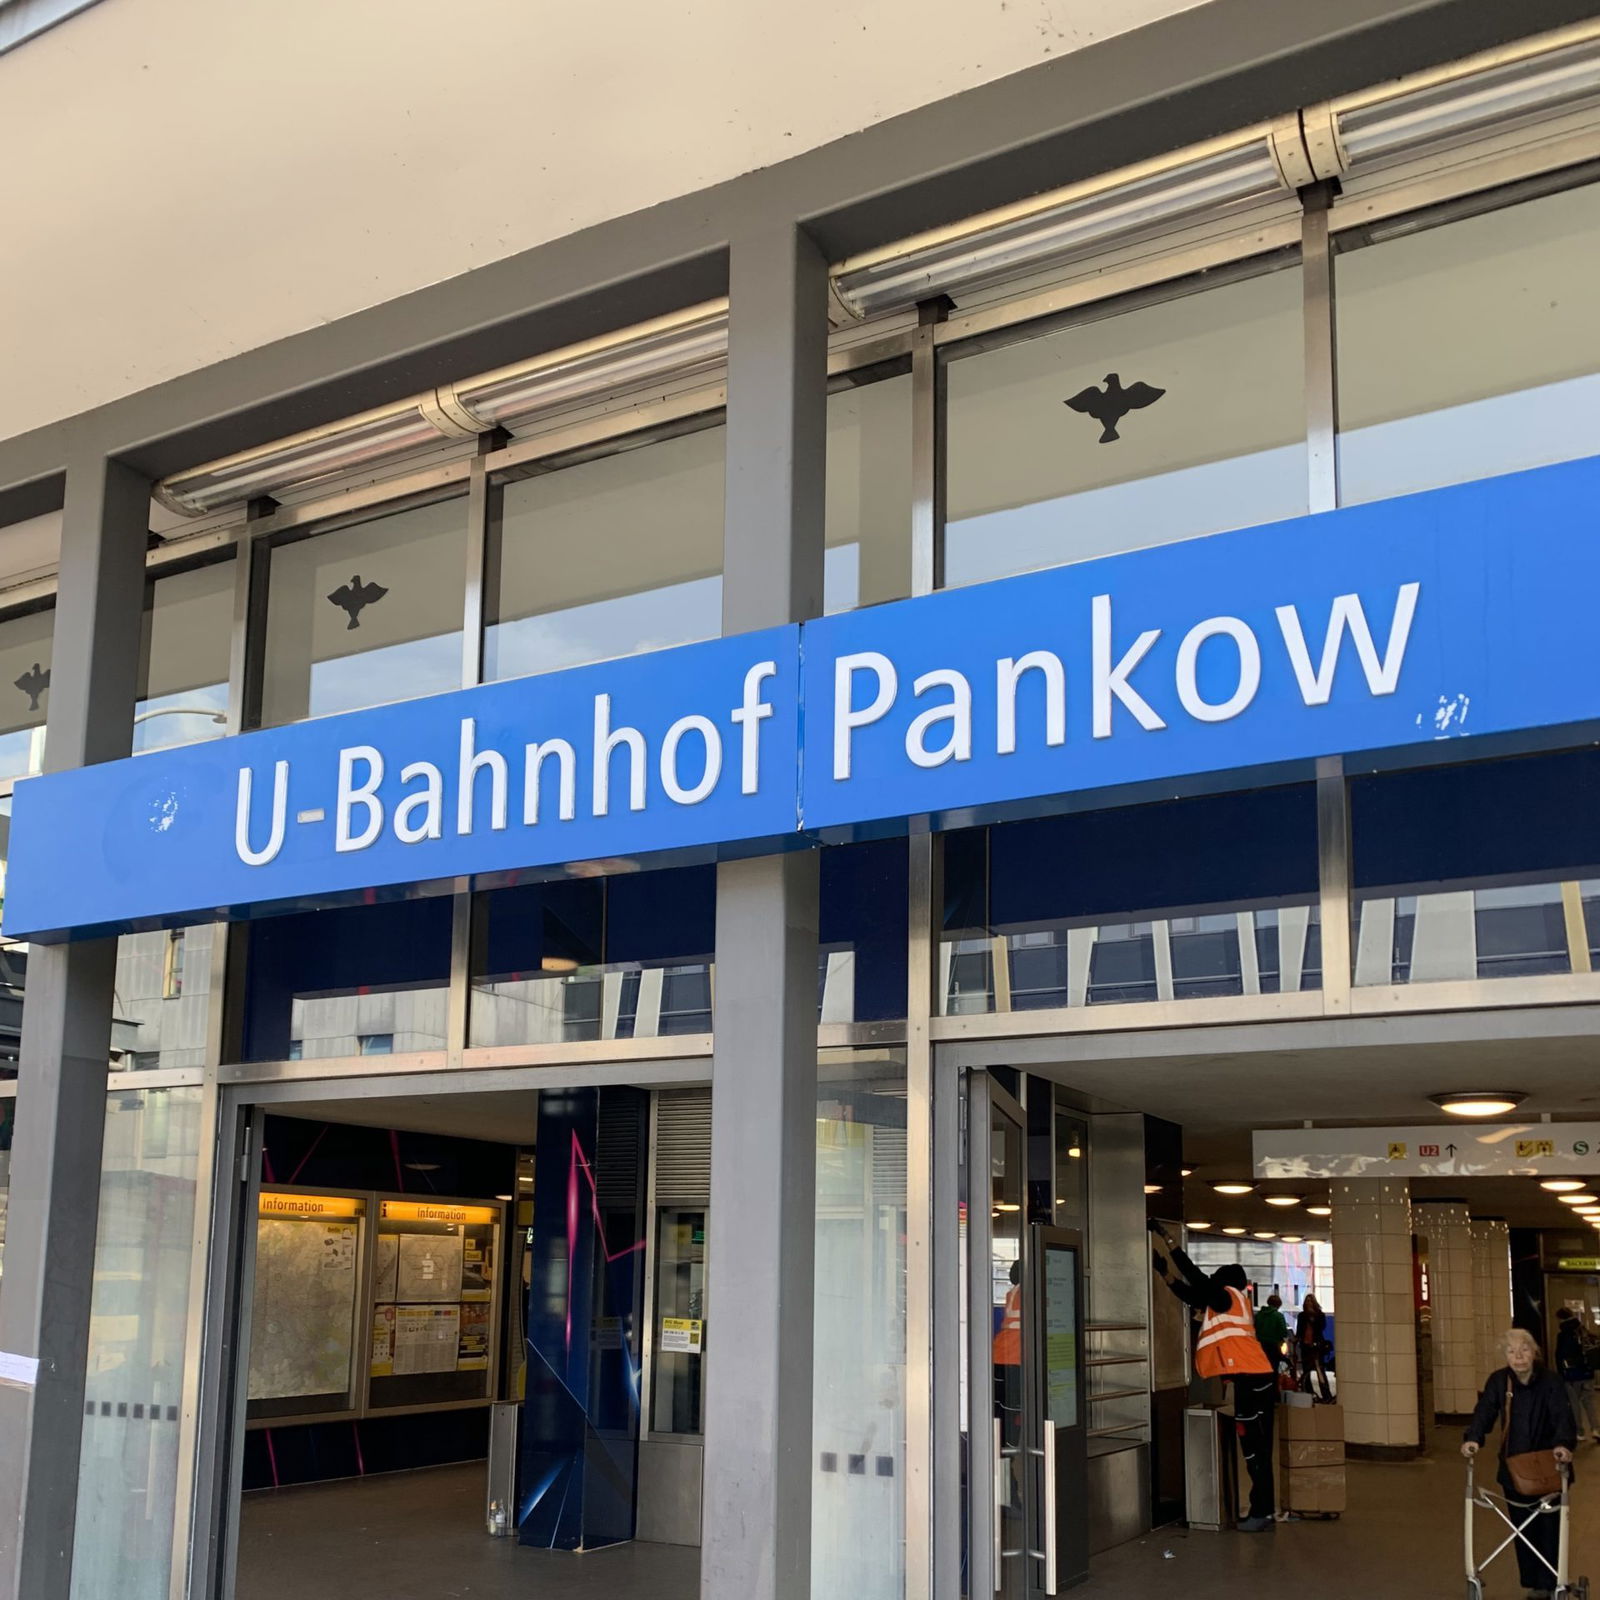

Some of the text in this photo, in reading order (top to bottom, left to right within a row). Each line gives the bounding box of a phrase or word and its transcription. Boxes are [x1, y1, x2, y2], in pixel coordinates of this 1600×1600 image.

[235, 582, 1419, 865] U-Bahnhof Pankow
[1421, 1146, 1438, 1156] U2
[263, 1198, 324, 1212] Information
[418, 1206, 466, 1220] Information
